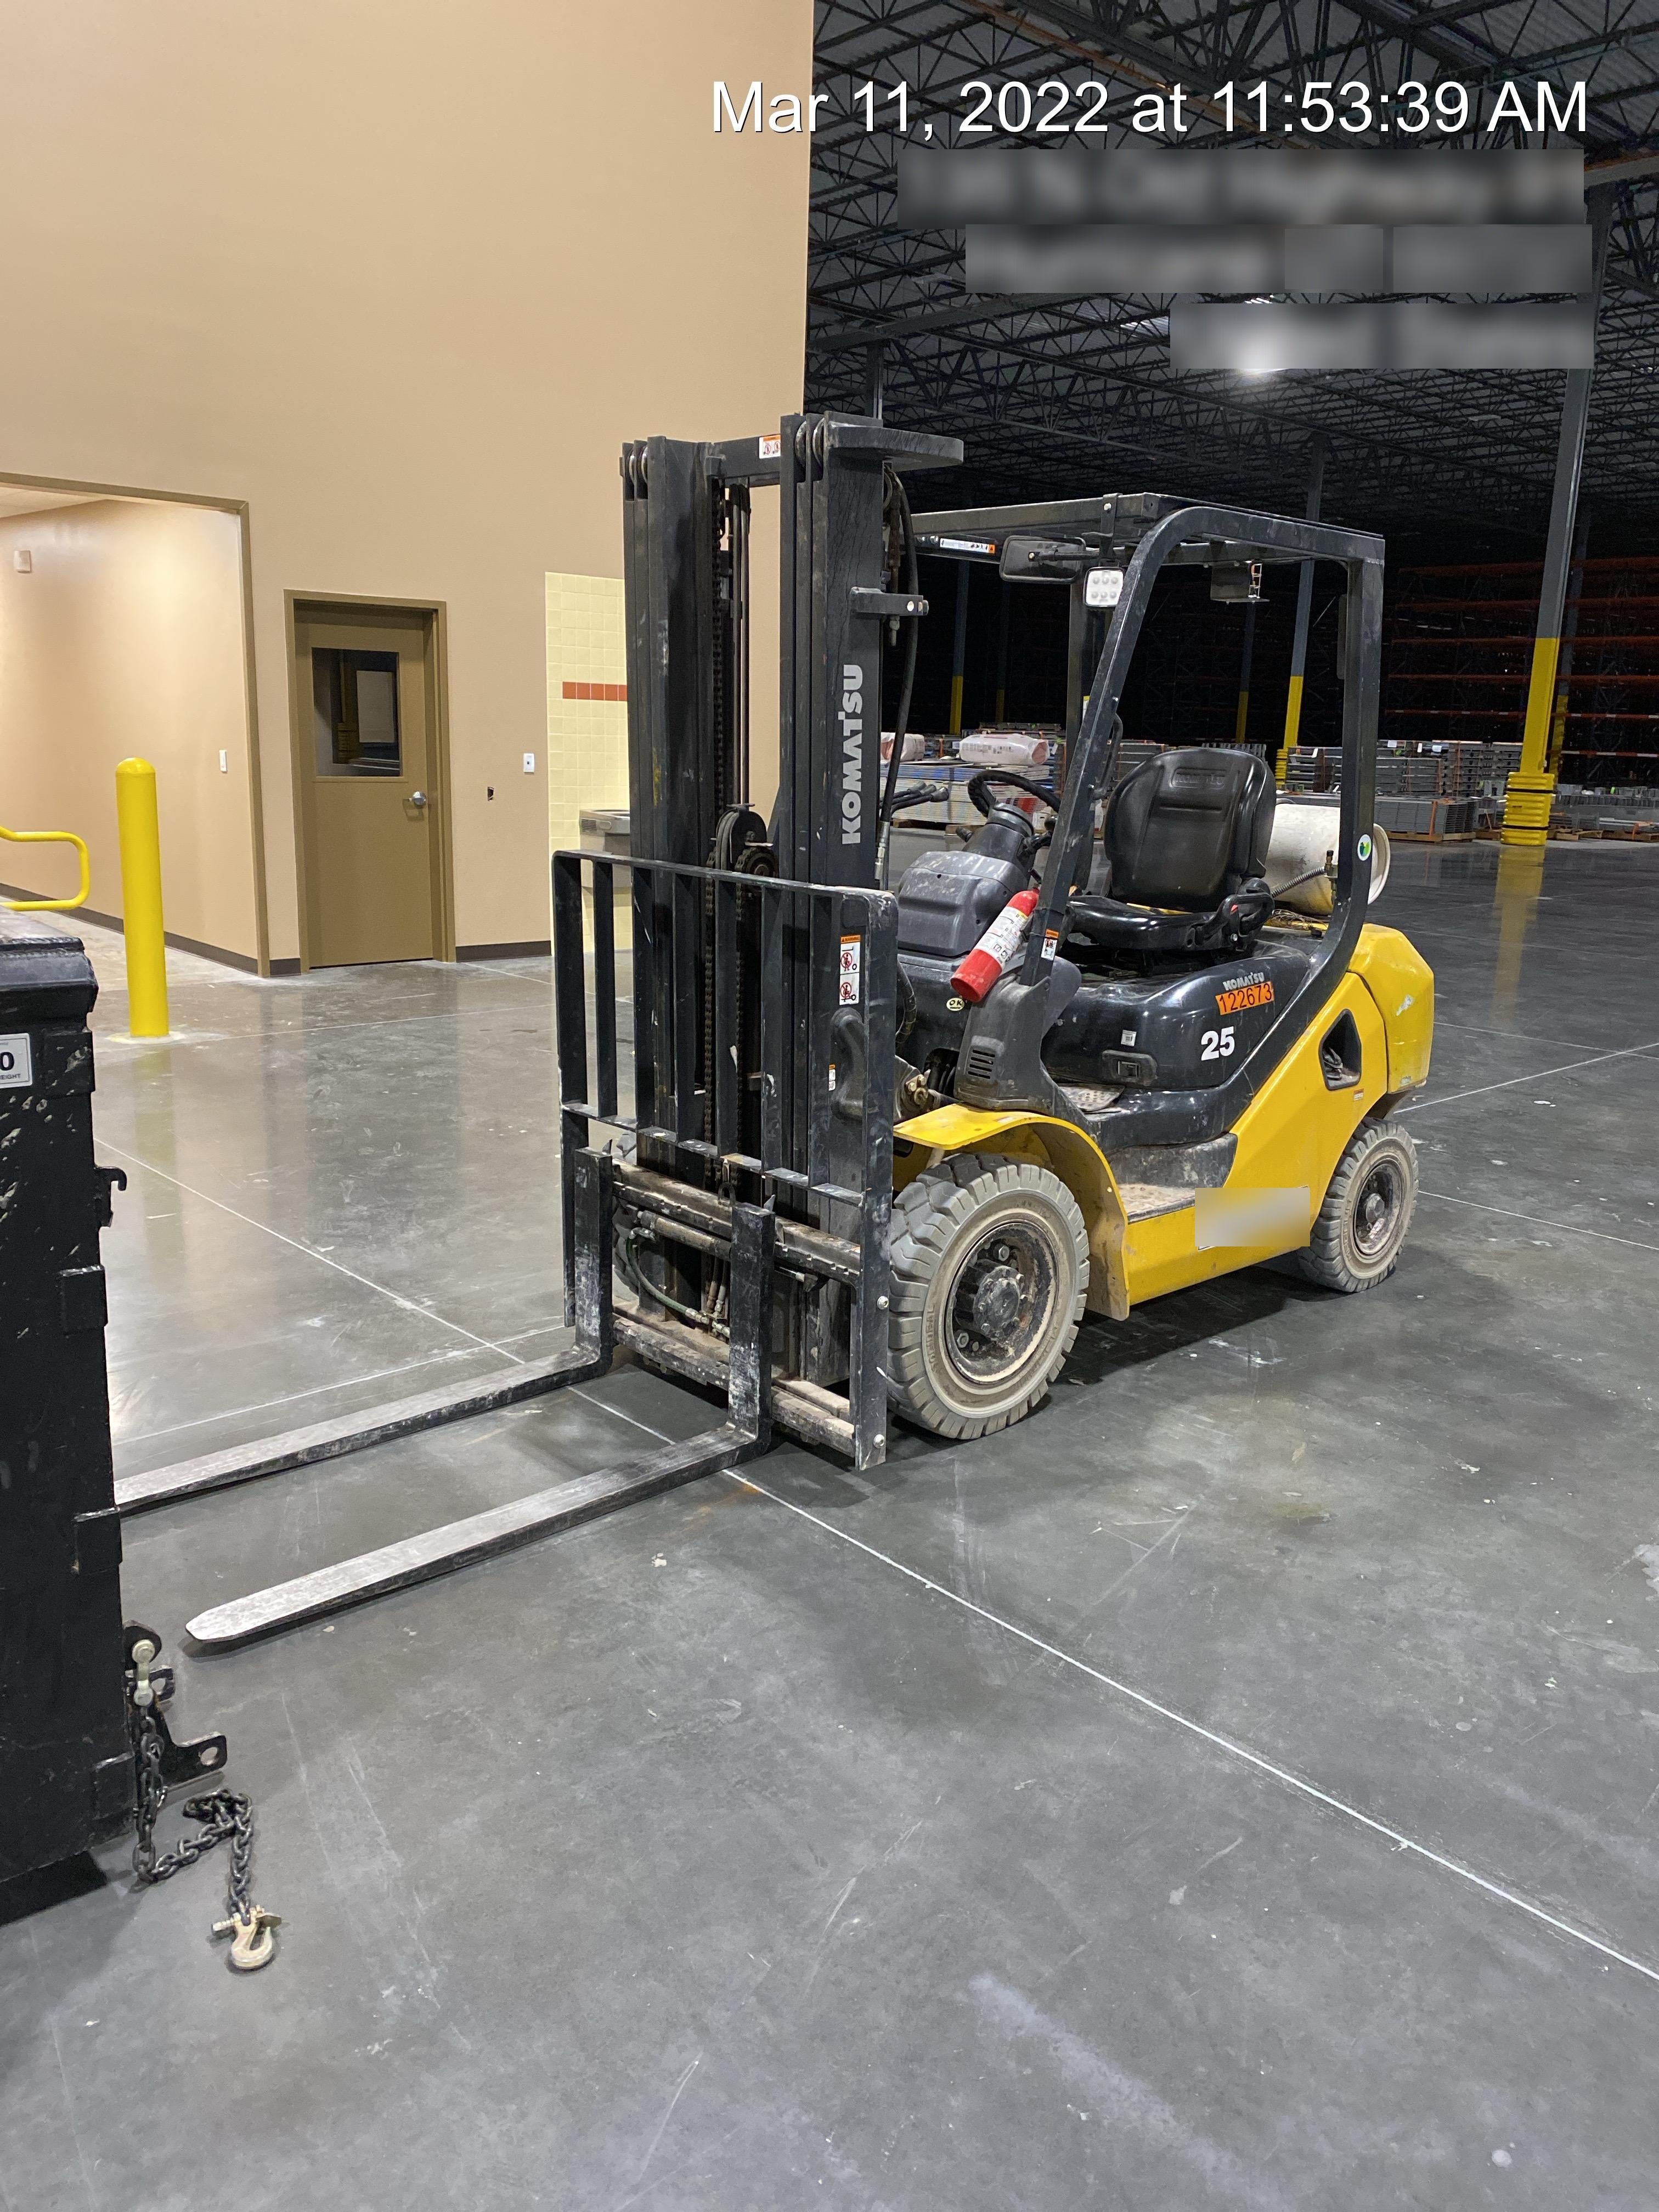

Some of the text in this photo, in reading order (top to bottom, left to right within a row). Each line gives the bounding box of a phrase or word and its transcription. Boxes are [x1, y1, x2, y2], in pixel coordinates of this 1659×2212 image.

[838, 664, 863, 844] KOMATSU
[1222, 972, 1265, 991] KOMATSU
[1219, 983, 1272, 1013] 122673
[1201, 1026, 1235, 1061] 25
